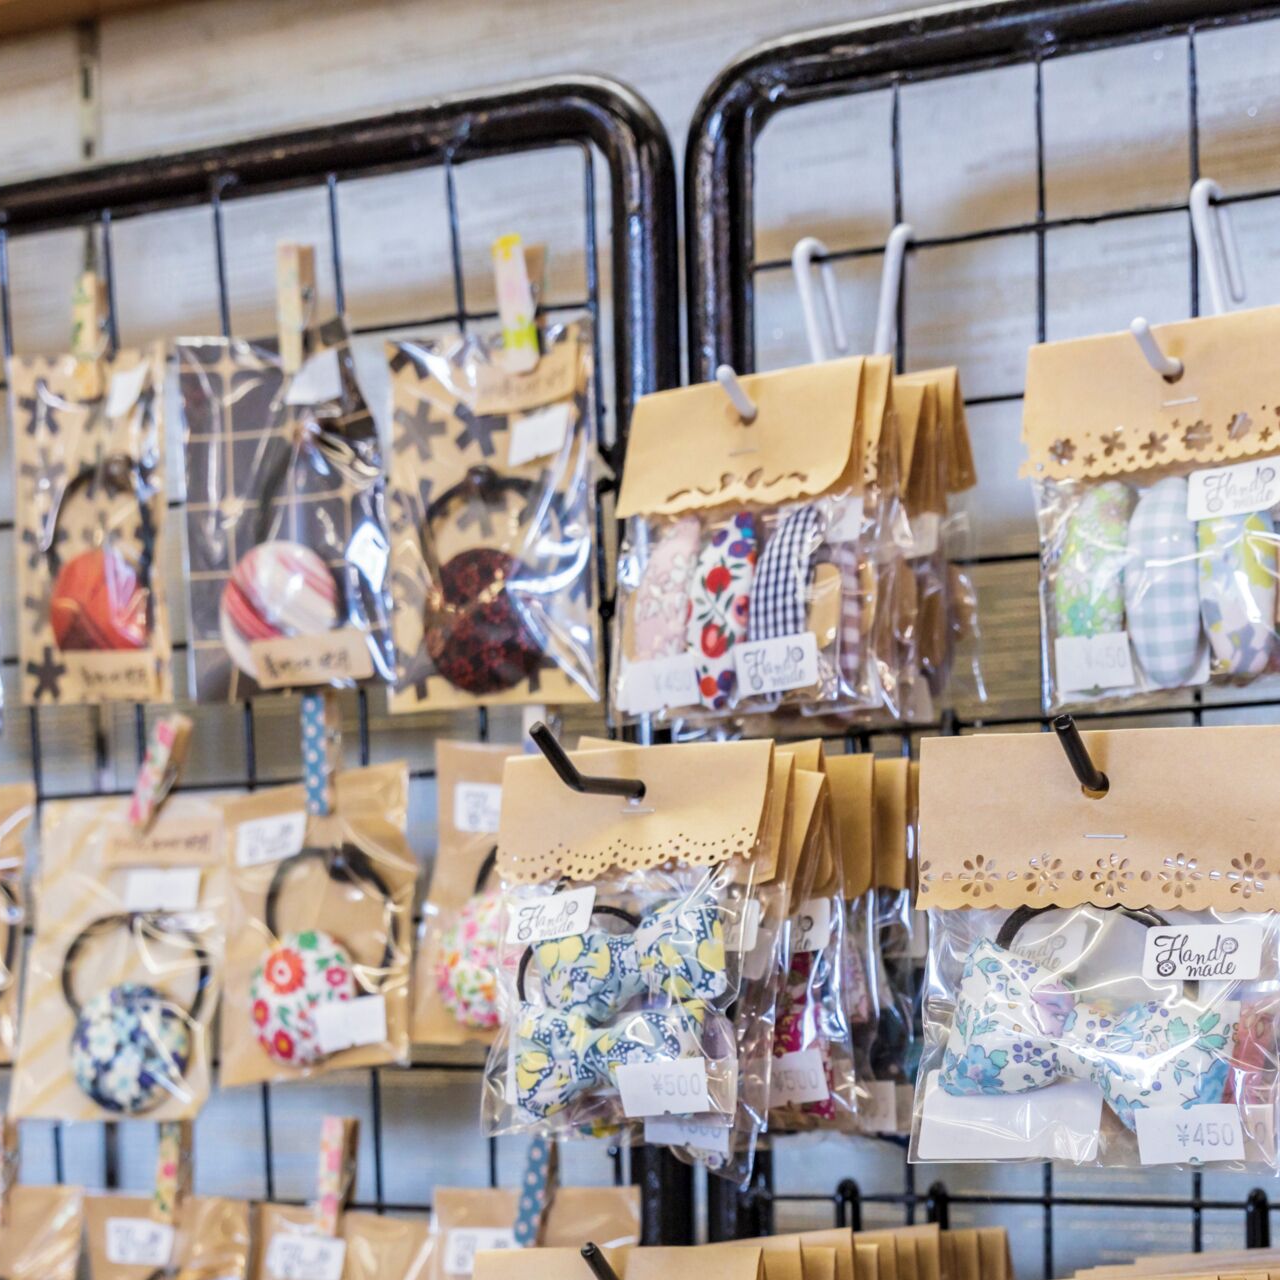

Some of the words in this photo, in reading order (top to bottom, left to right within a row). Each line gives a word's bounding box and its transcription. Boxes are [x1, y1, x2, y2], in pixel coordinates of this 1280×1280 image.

[519, 902, 568, 931] Hand
[539, 919, 574, 938] made
[1154, 933, 1220, 965] Hand
[1188, 959, 1236, 977] made
[652, 1072, 701, 1097] ¥500
[1176, 1121, 1234, 1147] ¥450
